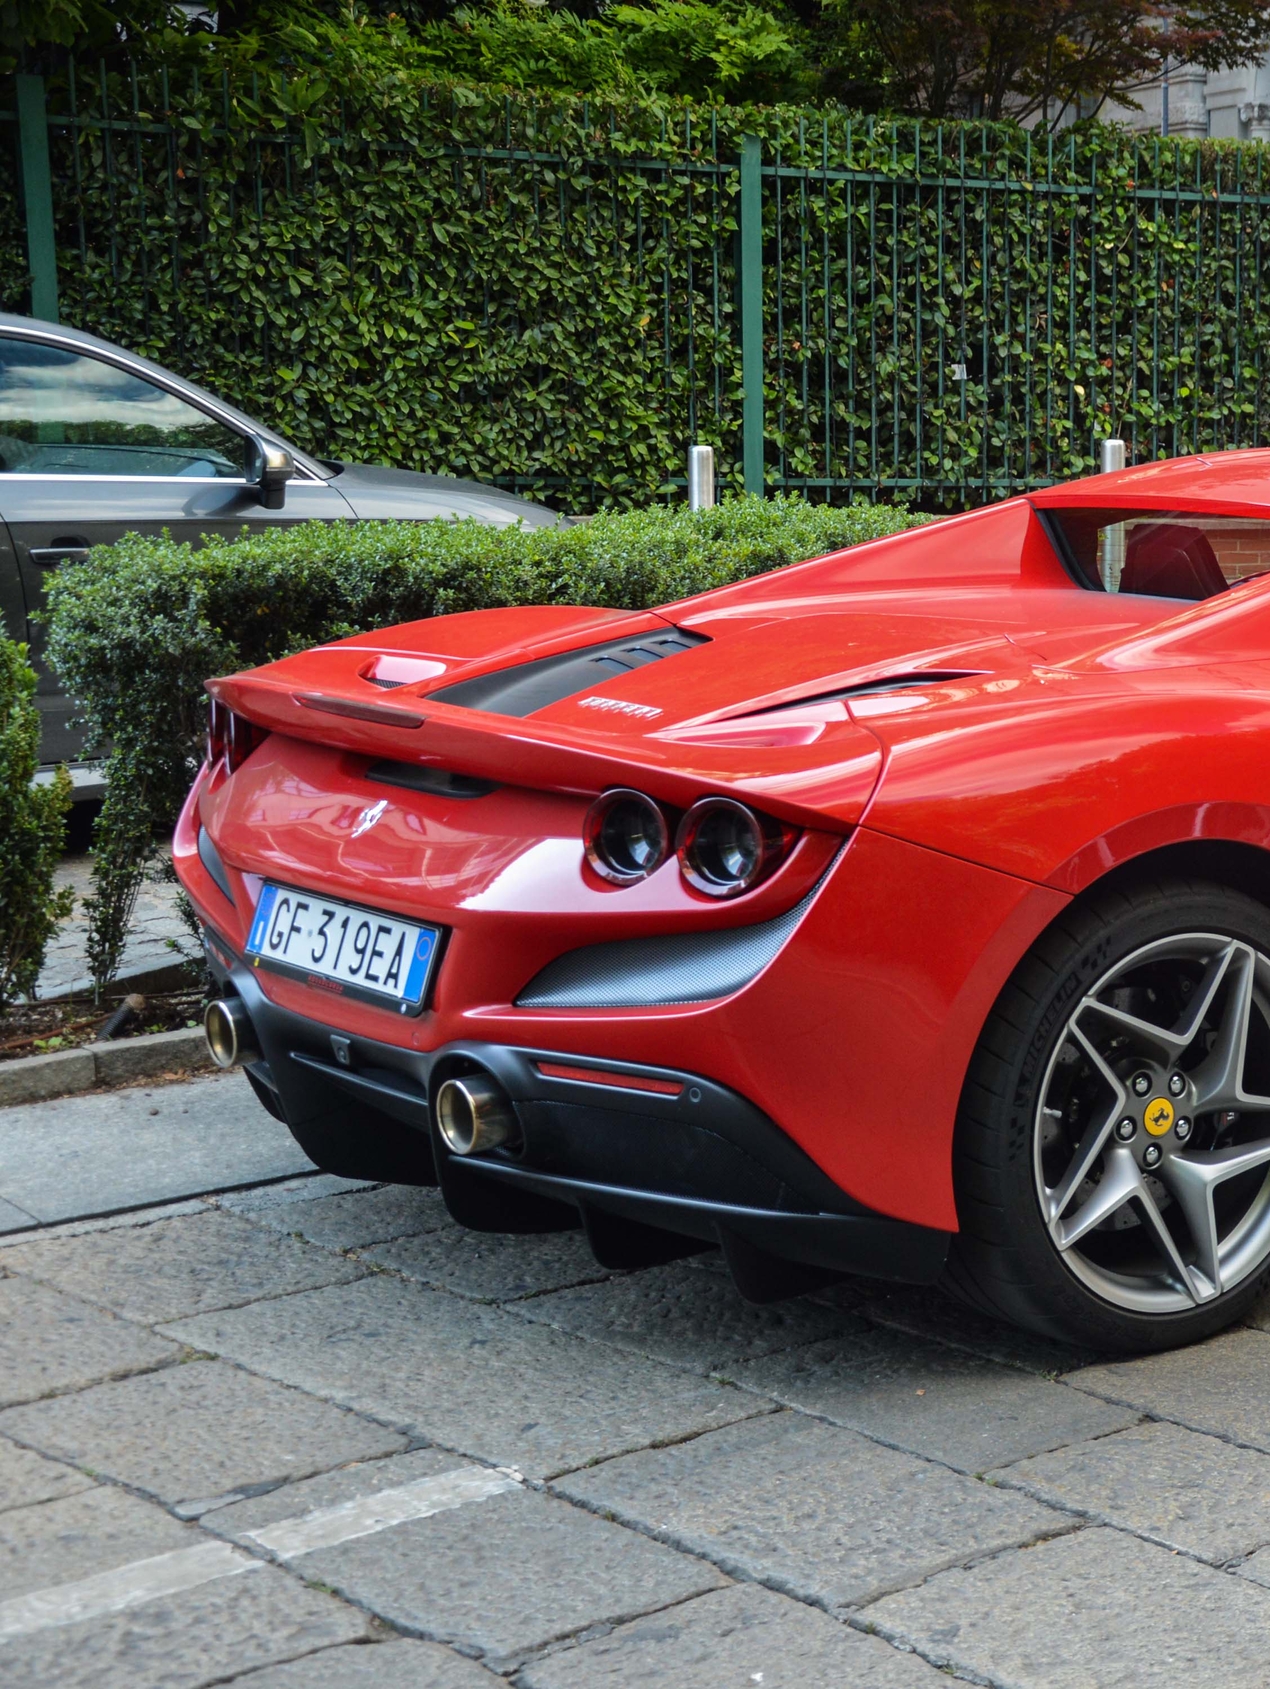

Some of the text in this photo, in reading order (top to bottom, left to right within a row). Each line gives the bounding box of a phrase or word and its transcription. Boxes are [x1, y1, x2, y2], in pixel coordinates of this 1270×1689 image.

[269, 897, 406, 988] GF 319EA
[1022, 972, 1083, 1079] MICHELIN
